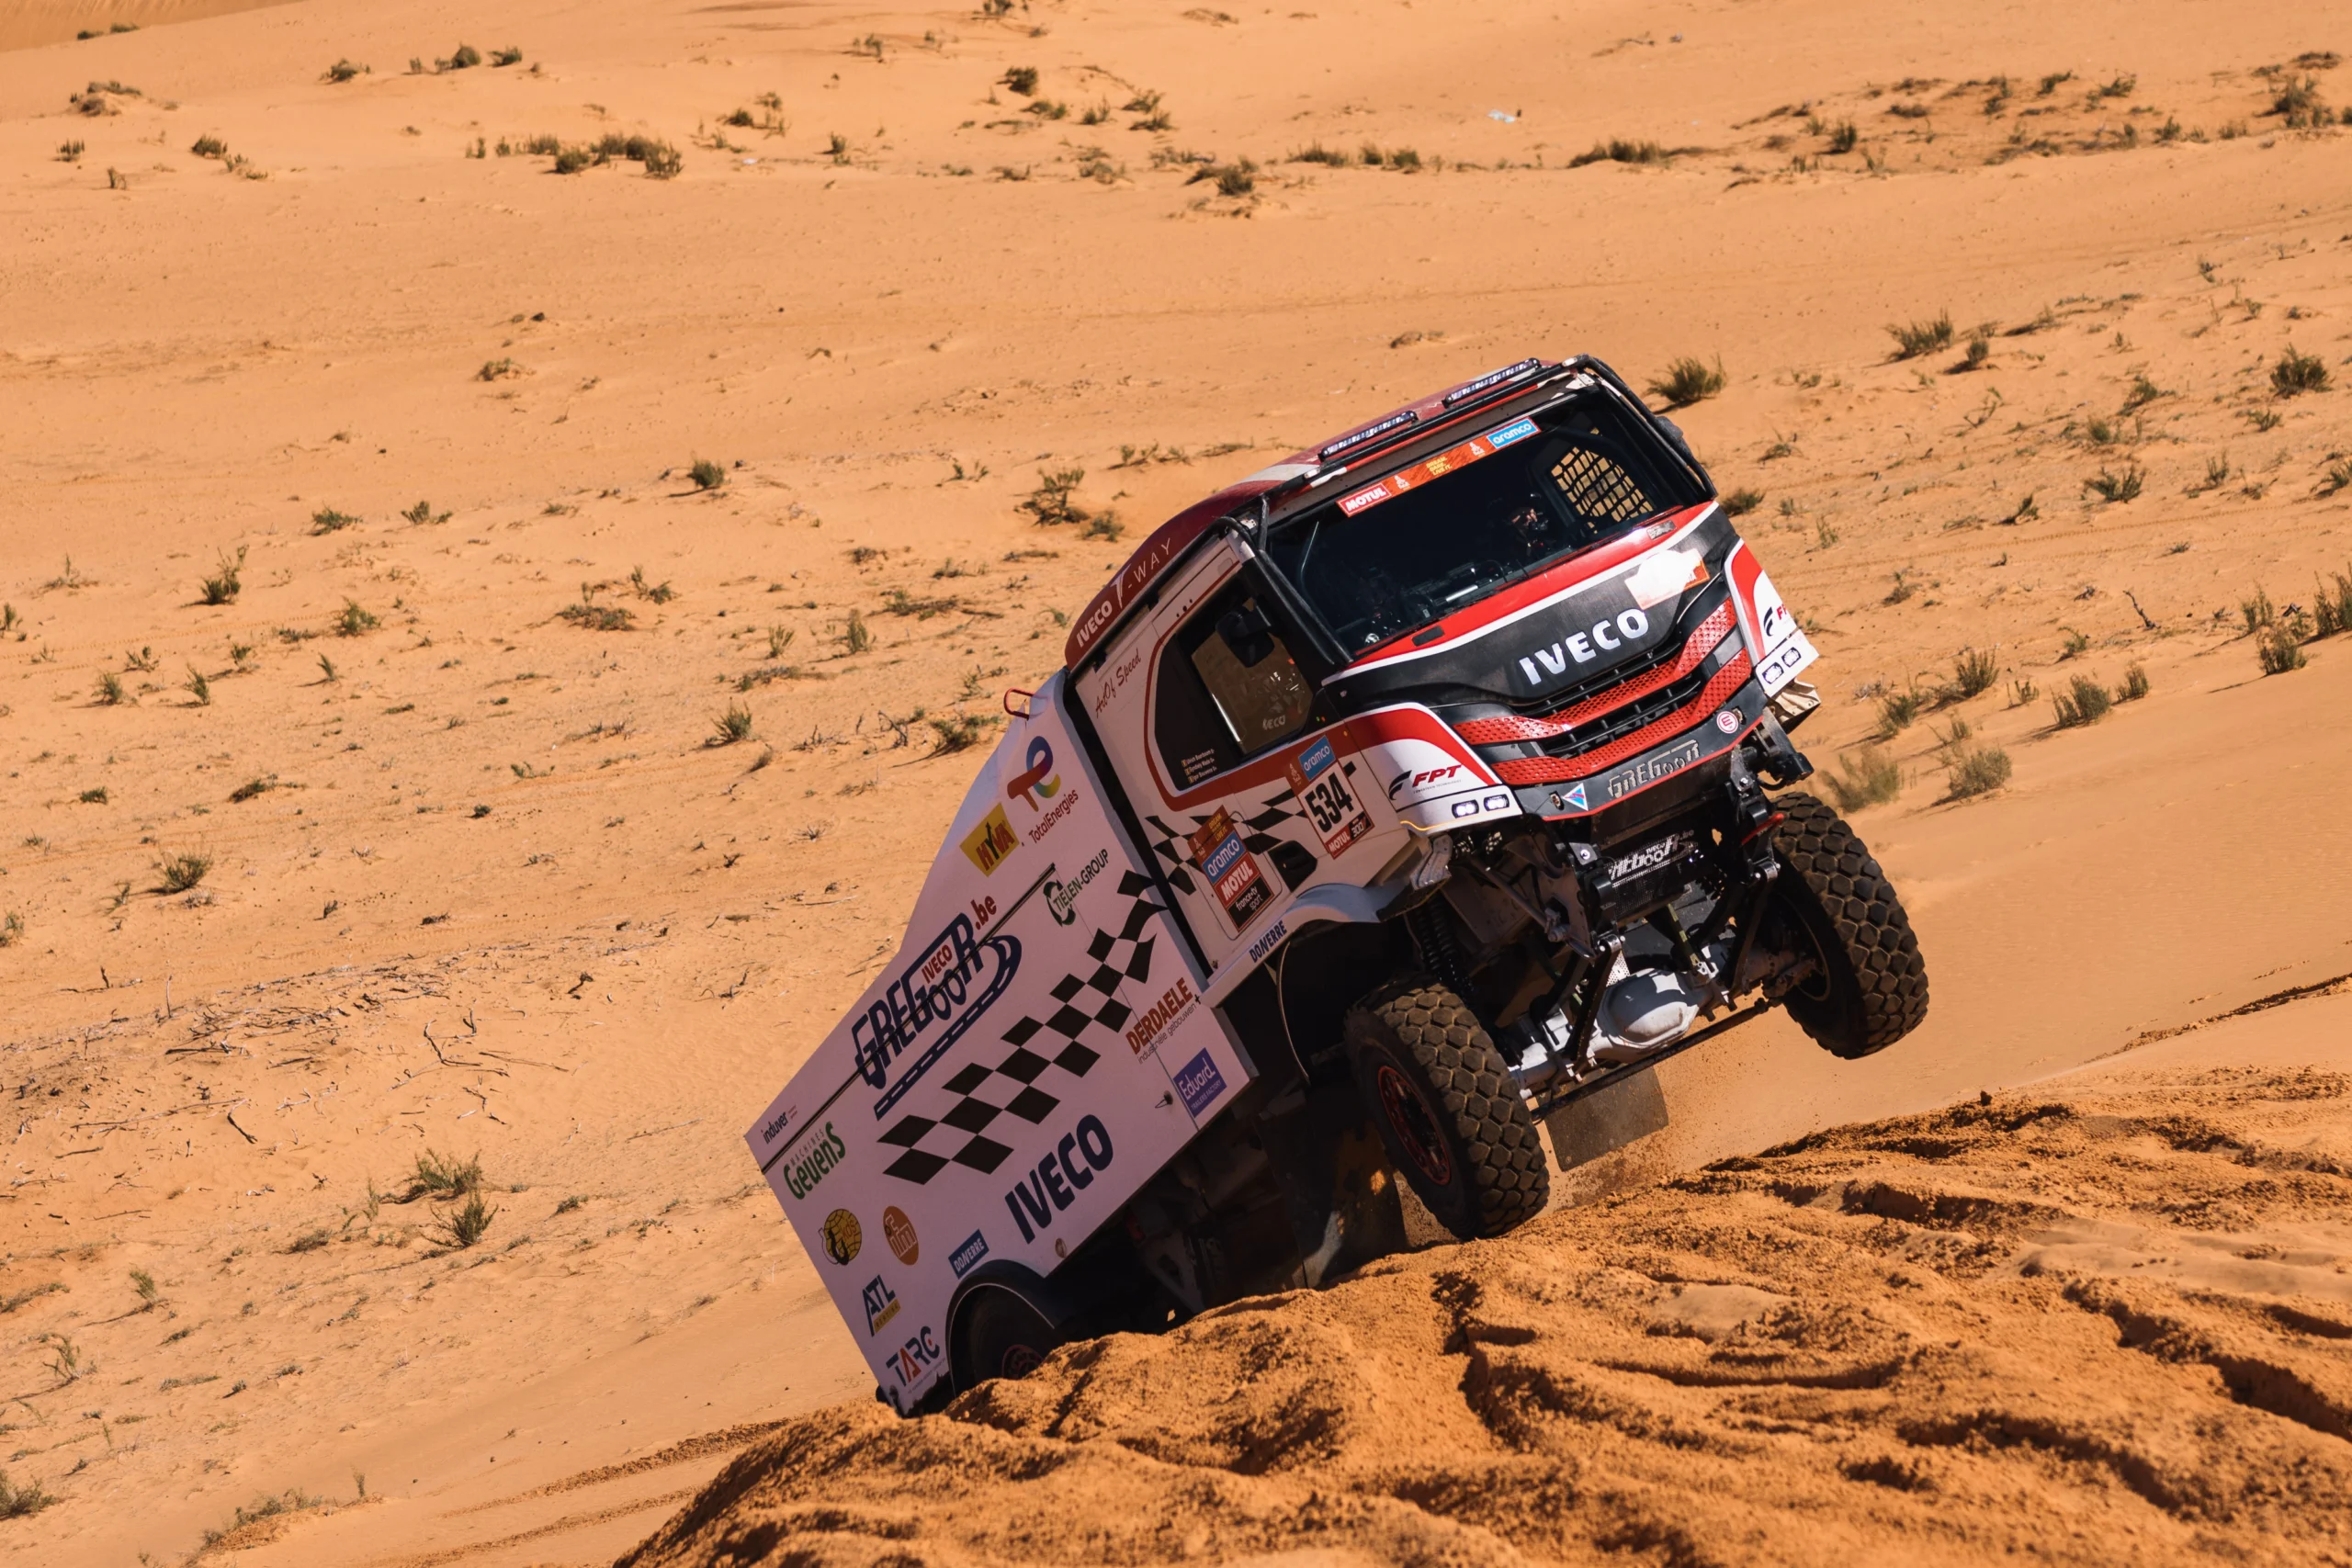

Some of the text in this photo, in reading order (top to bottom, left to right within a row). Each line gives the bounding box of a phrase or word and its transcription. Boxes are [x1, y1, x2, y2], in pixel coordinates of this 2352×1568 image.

[1492, 423, 1532, 446] aramco
[1345, 487, 1386, 512] MOTUL
[1076, 600, 1114, 649] IVECO
[1116, 647, 1142, 687] Speed
[1519, 607, 1650, 686] IVECO
[1304, 745, 1330, 772] aramco
[1412, 764, 1462, 788] FPT
[1028, 789, 1080, 844] TotalEnergies
[1305, 773, 1354, 833] 534
[975, 821, 1015, 871] HYVA
[1207, 839, 1240, 877] aramco
[1328, 831, 1351, 852] MOTUL
[1053, 848, 1110, 912] TIELEN-GROUP
[1221, 859, 1253, 900] MOTUL
[921, 944, 953, 984] IVECO
[1125, 977, 1193, 1055] DERDAELE
[1167, 1003, 1197, 1037] gebouwen
[1180, 1057, 1216, 1100] Eduard
[761, 1111, 788, 1145] induver
[790, 1129, 824, 1166] MACHINES
[1004, 1114, 1114, 1245] IVECO
[863, 1274, 896, 1337] ATL
[886, 1325, 940, 1387] TARC
